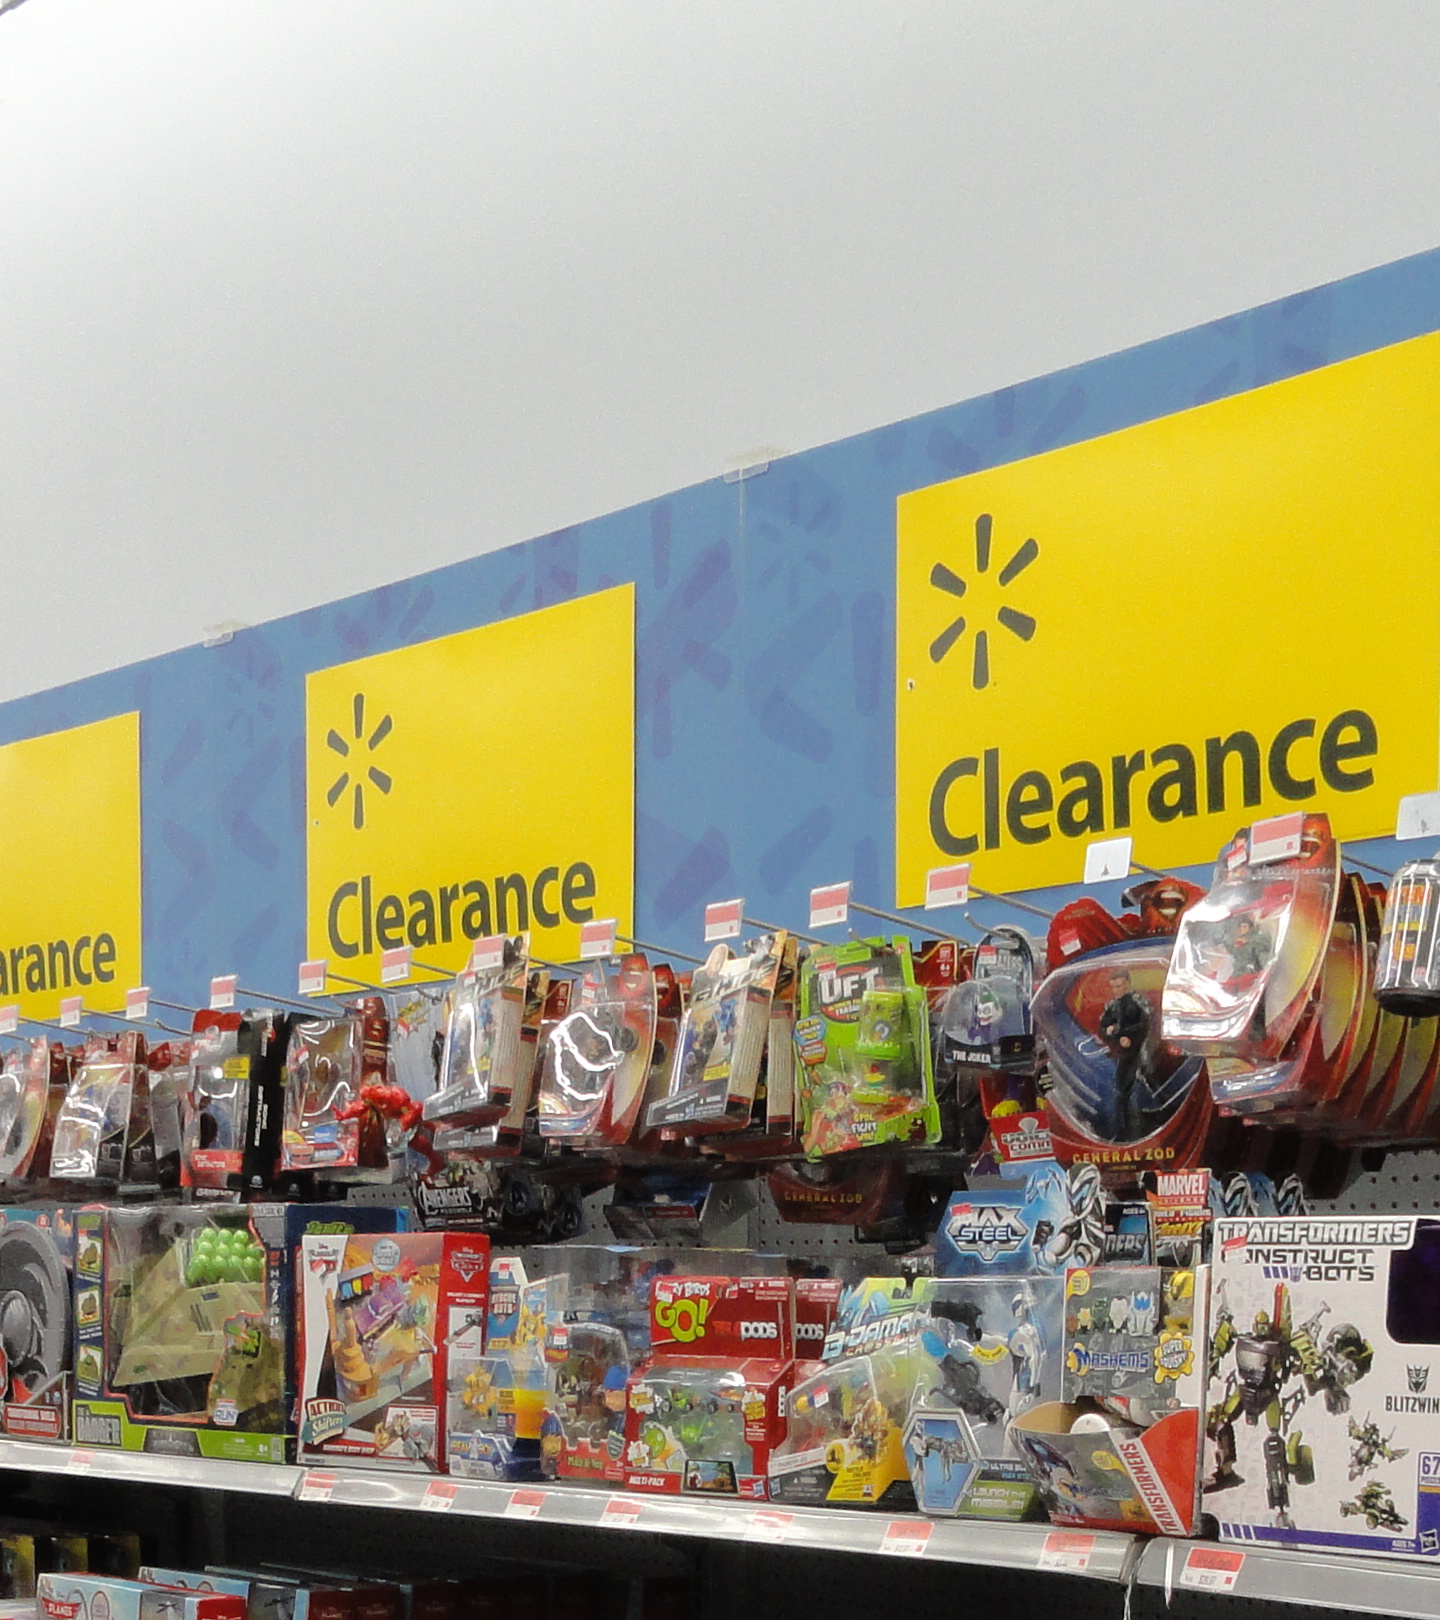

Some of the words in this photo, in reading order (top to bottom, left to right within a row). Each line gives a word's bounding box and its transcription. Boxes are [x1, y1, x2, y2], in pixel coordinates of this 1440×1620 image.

[929, 709, 1378, 857] Clearance
[327, 862, 596, 958] Clearance
[1073, 1149, 1139, 1163] GENERAL
[1145, 1147, 1175, 1161] ZOD
[1158, 1175, 1206, 1196] MARVEL
[959, 1227, 1021, 1242] STEEL
[1219, 1221, 1411, 1246] TRANSFORMERS
[1222, 1249, 1374, 1263] NSTRUCT
[656, 1298, 709, 1343] GO!
[1161, 1342, 1185, 1356] SUPER
[309, 1401, 345, 1419] ACTION
[1119, 1441, 1177, 1534] TRANSFORMERS
